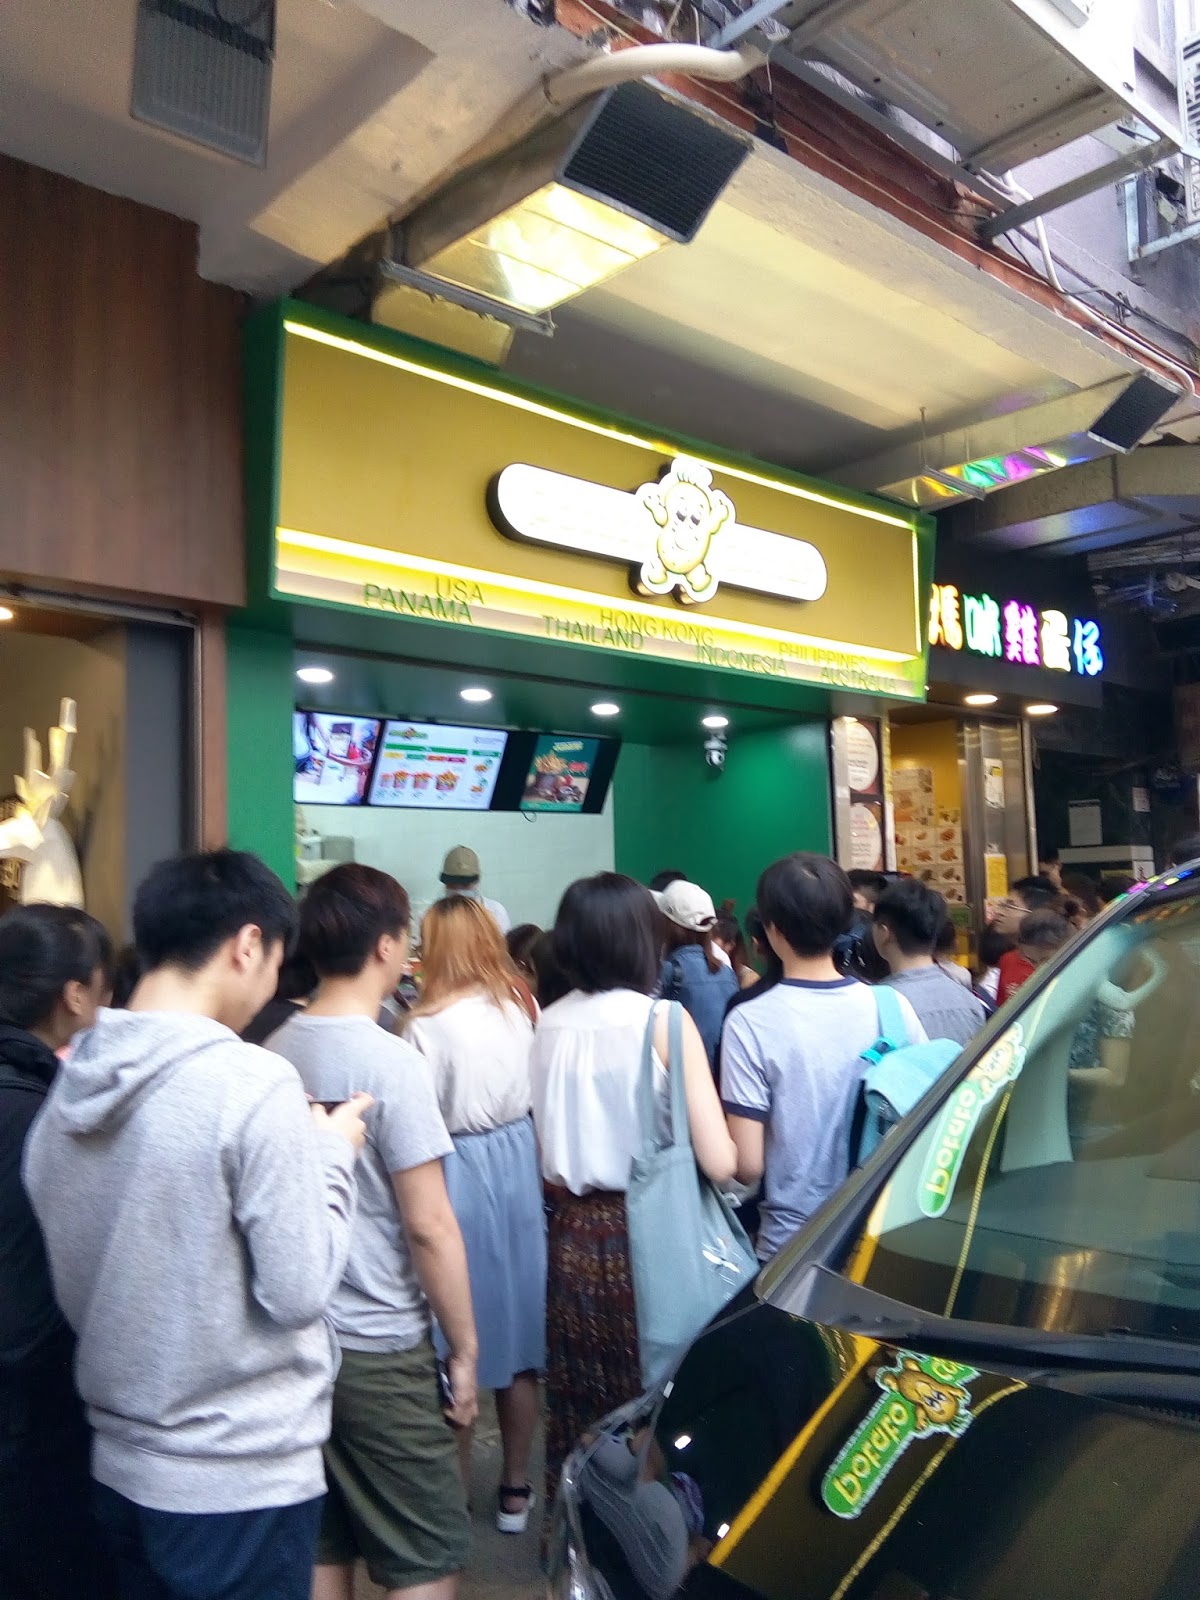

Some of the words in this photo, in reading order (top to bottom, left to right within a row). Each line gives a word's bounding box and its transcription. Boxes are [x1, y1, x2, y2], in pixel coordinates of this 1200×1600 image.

[363, 583, 473, 625] PANAMA
[435, 576, 485, 605] USA
[543, 614, 644, 651] THAILAND
[600, 608, 657, 636] HONG
[661, 619, 714, 646] KONG
[696, 645, 787, 677] INDONESIA
